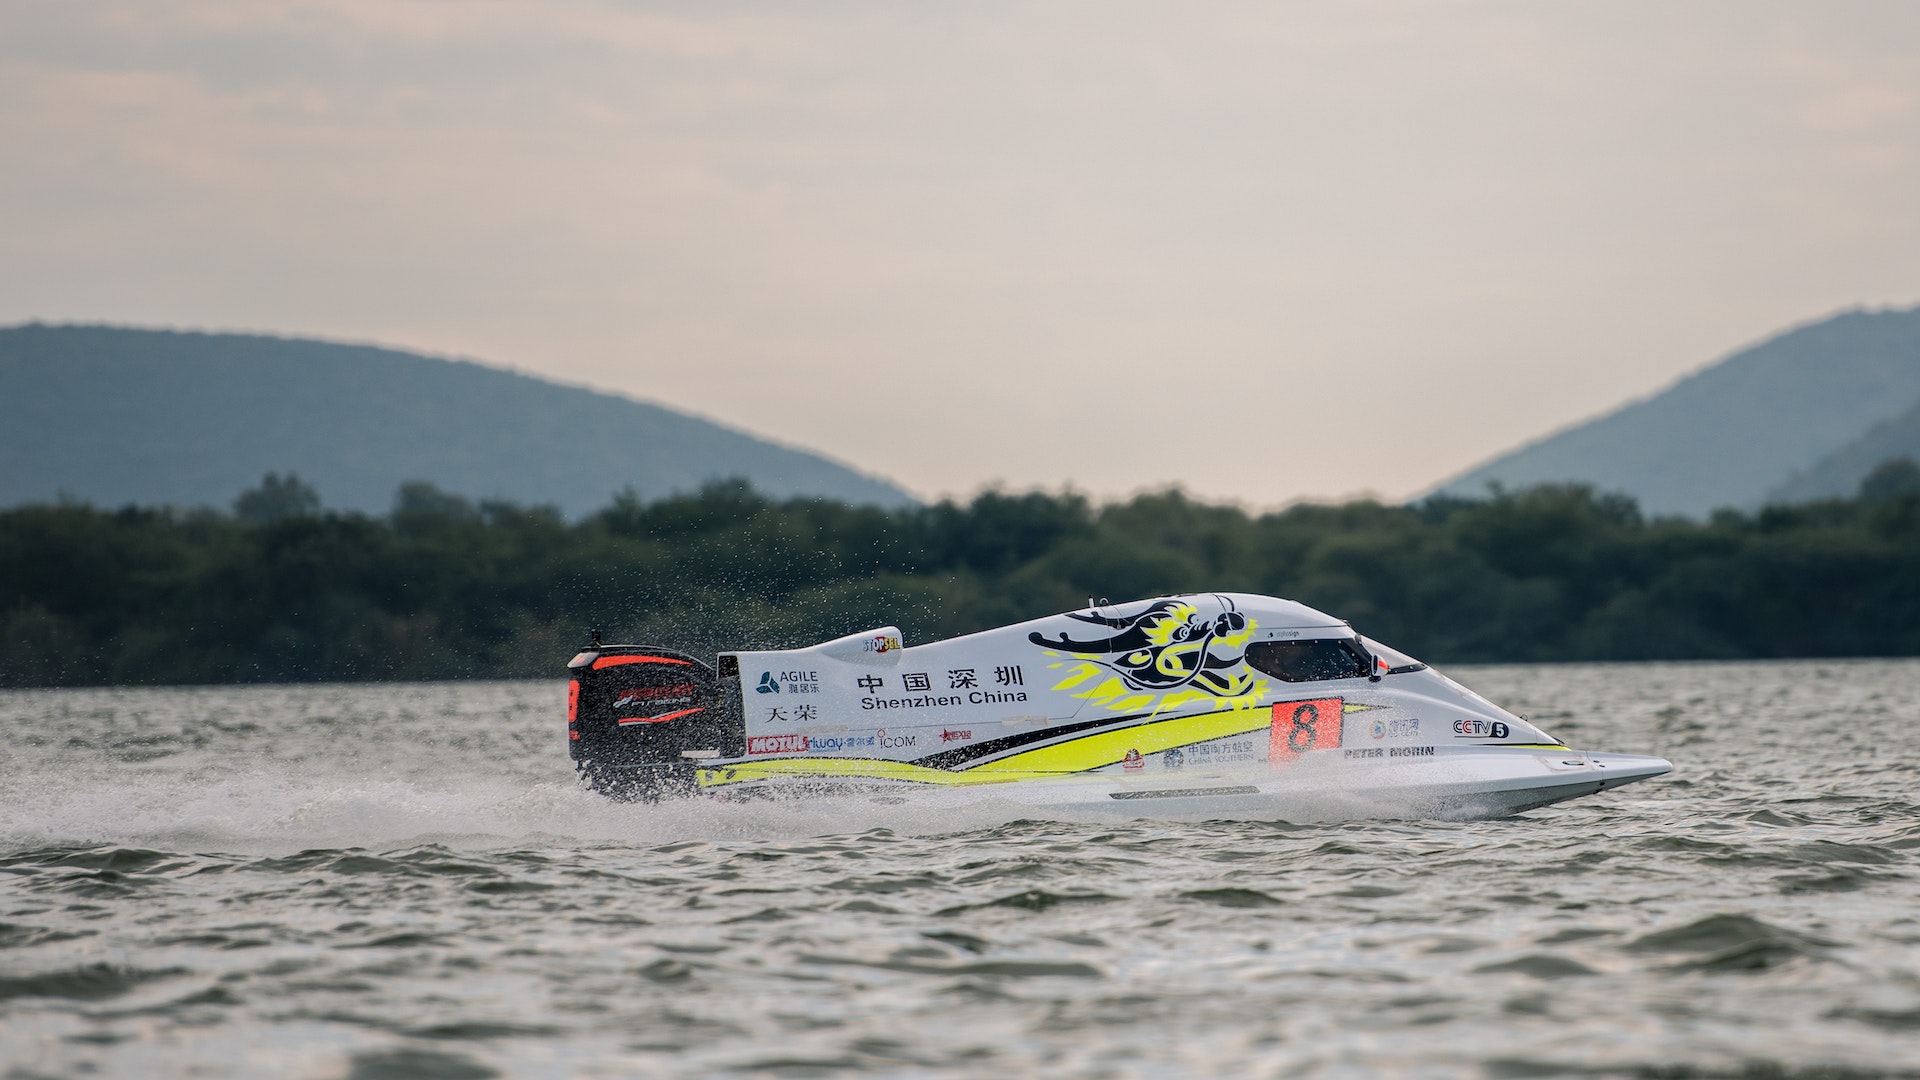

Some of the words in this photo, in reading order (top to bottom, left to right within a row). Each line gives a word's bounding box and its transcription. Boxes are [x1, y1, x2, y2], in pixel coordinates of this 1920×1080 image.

[863, 636, 900, 652] STOPSEL
[780, 671, 819, 682] AGILE
[788, 683, 820, 694] 雅居乐
[861, 695, 962, 710] Shenzhen
[968, 690, 1027, 705] China
[1288, 704, 1319, 753] 8
[750, 735, 808, 754] MOTUL
[1343, 748, 1384, 759] PETER
[1390, 746, 1434, 757] MORIN
